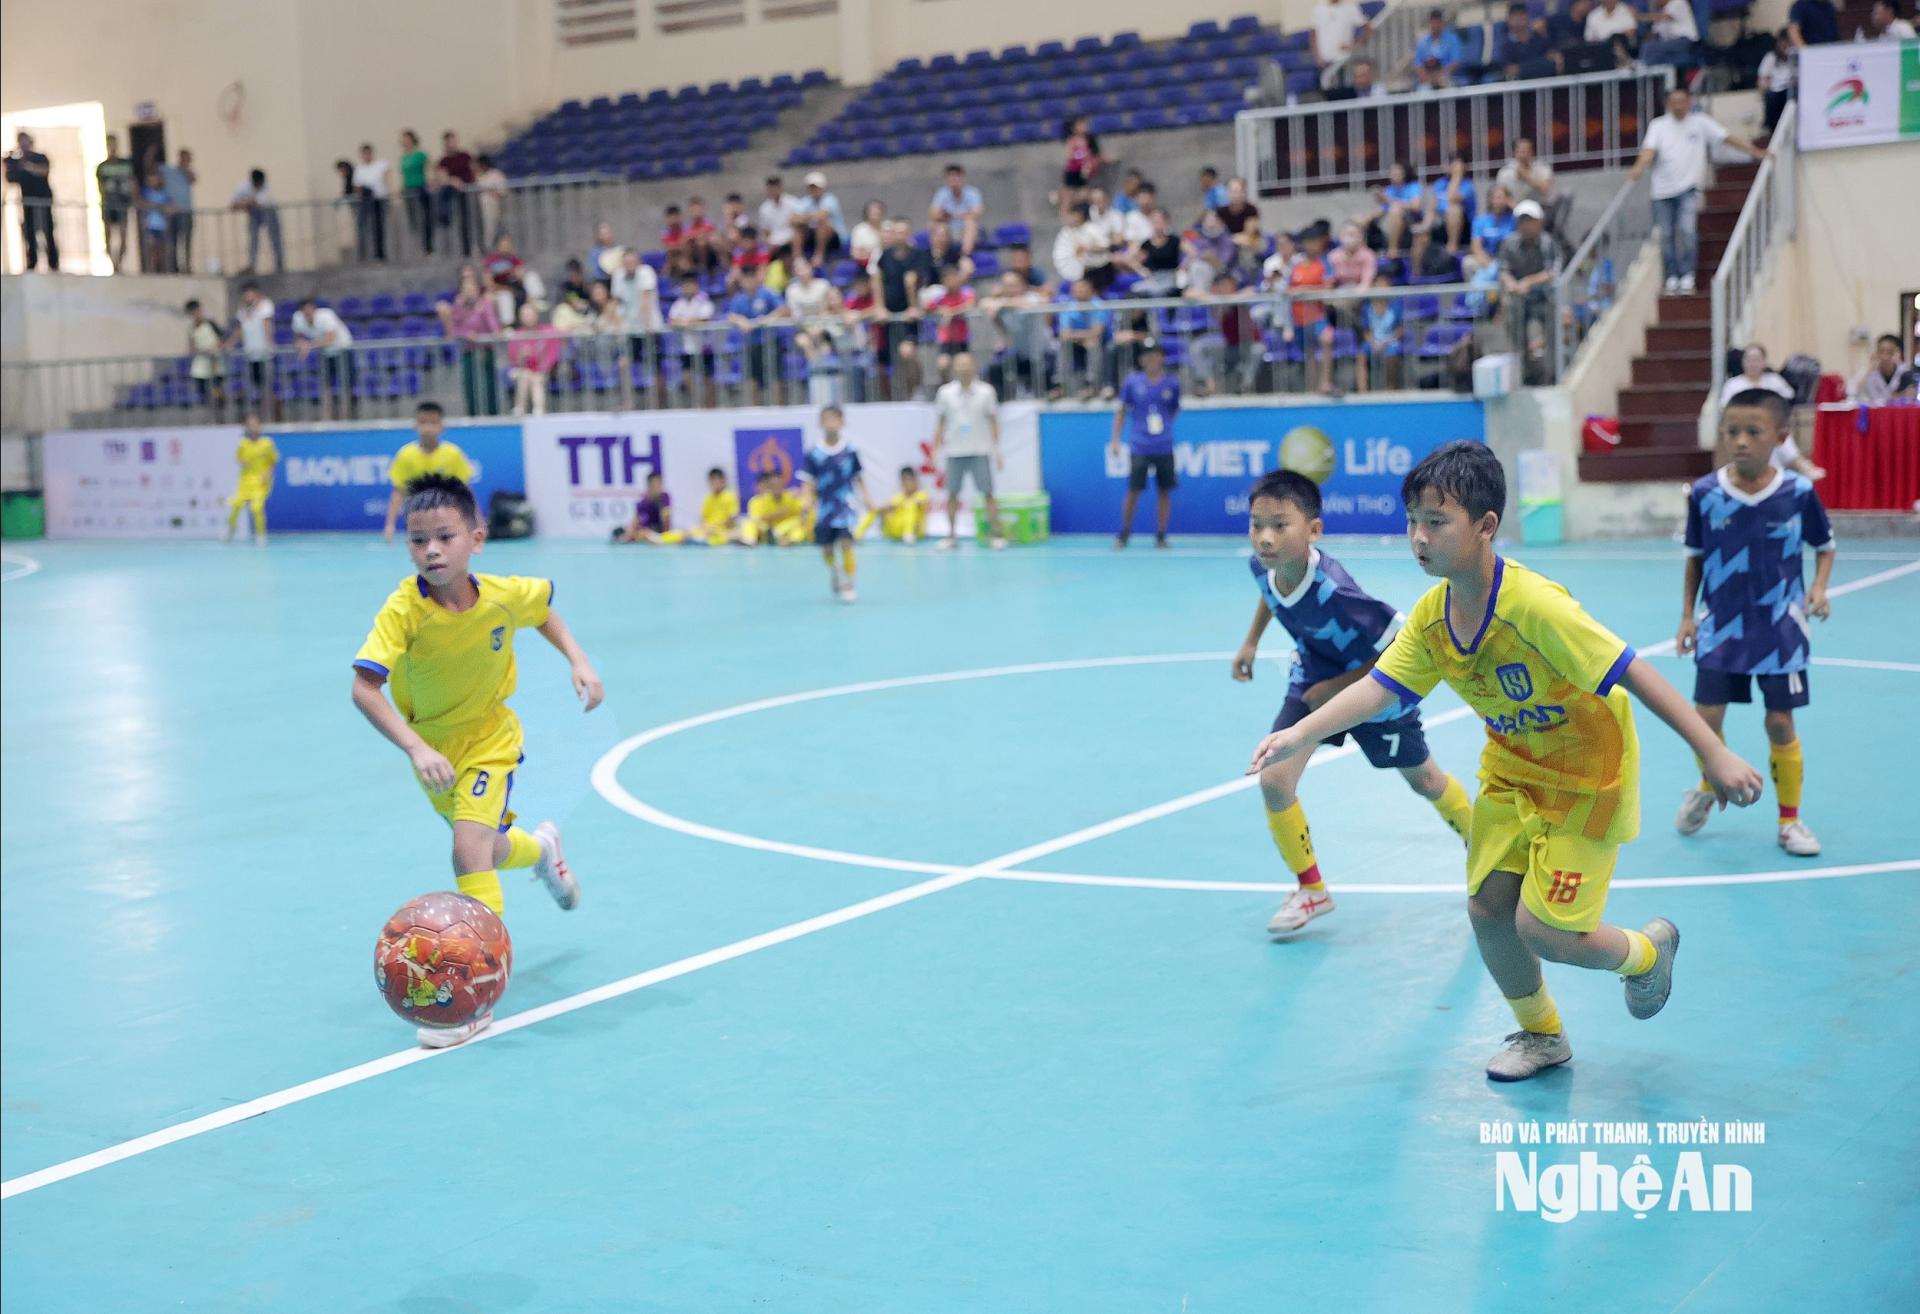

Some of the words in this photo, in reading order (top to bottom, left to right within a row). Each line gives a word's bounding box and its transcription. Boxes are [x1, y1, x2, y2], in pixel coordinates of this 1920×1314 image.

[557, 434, 662, 485] TTH
[1344, 437, 1412, 475] Life
[1382, 732, 1400, 757] 7
[472, 770, 490, 796] 6
[1547, 870, 1583, 904] 18
